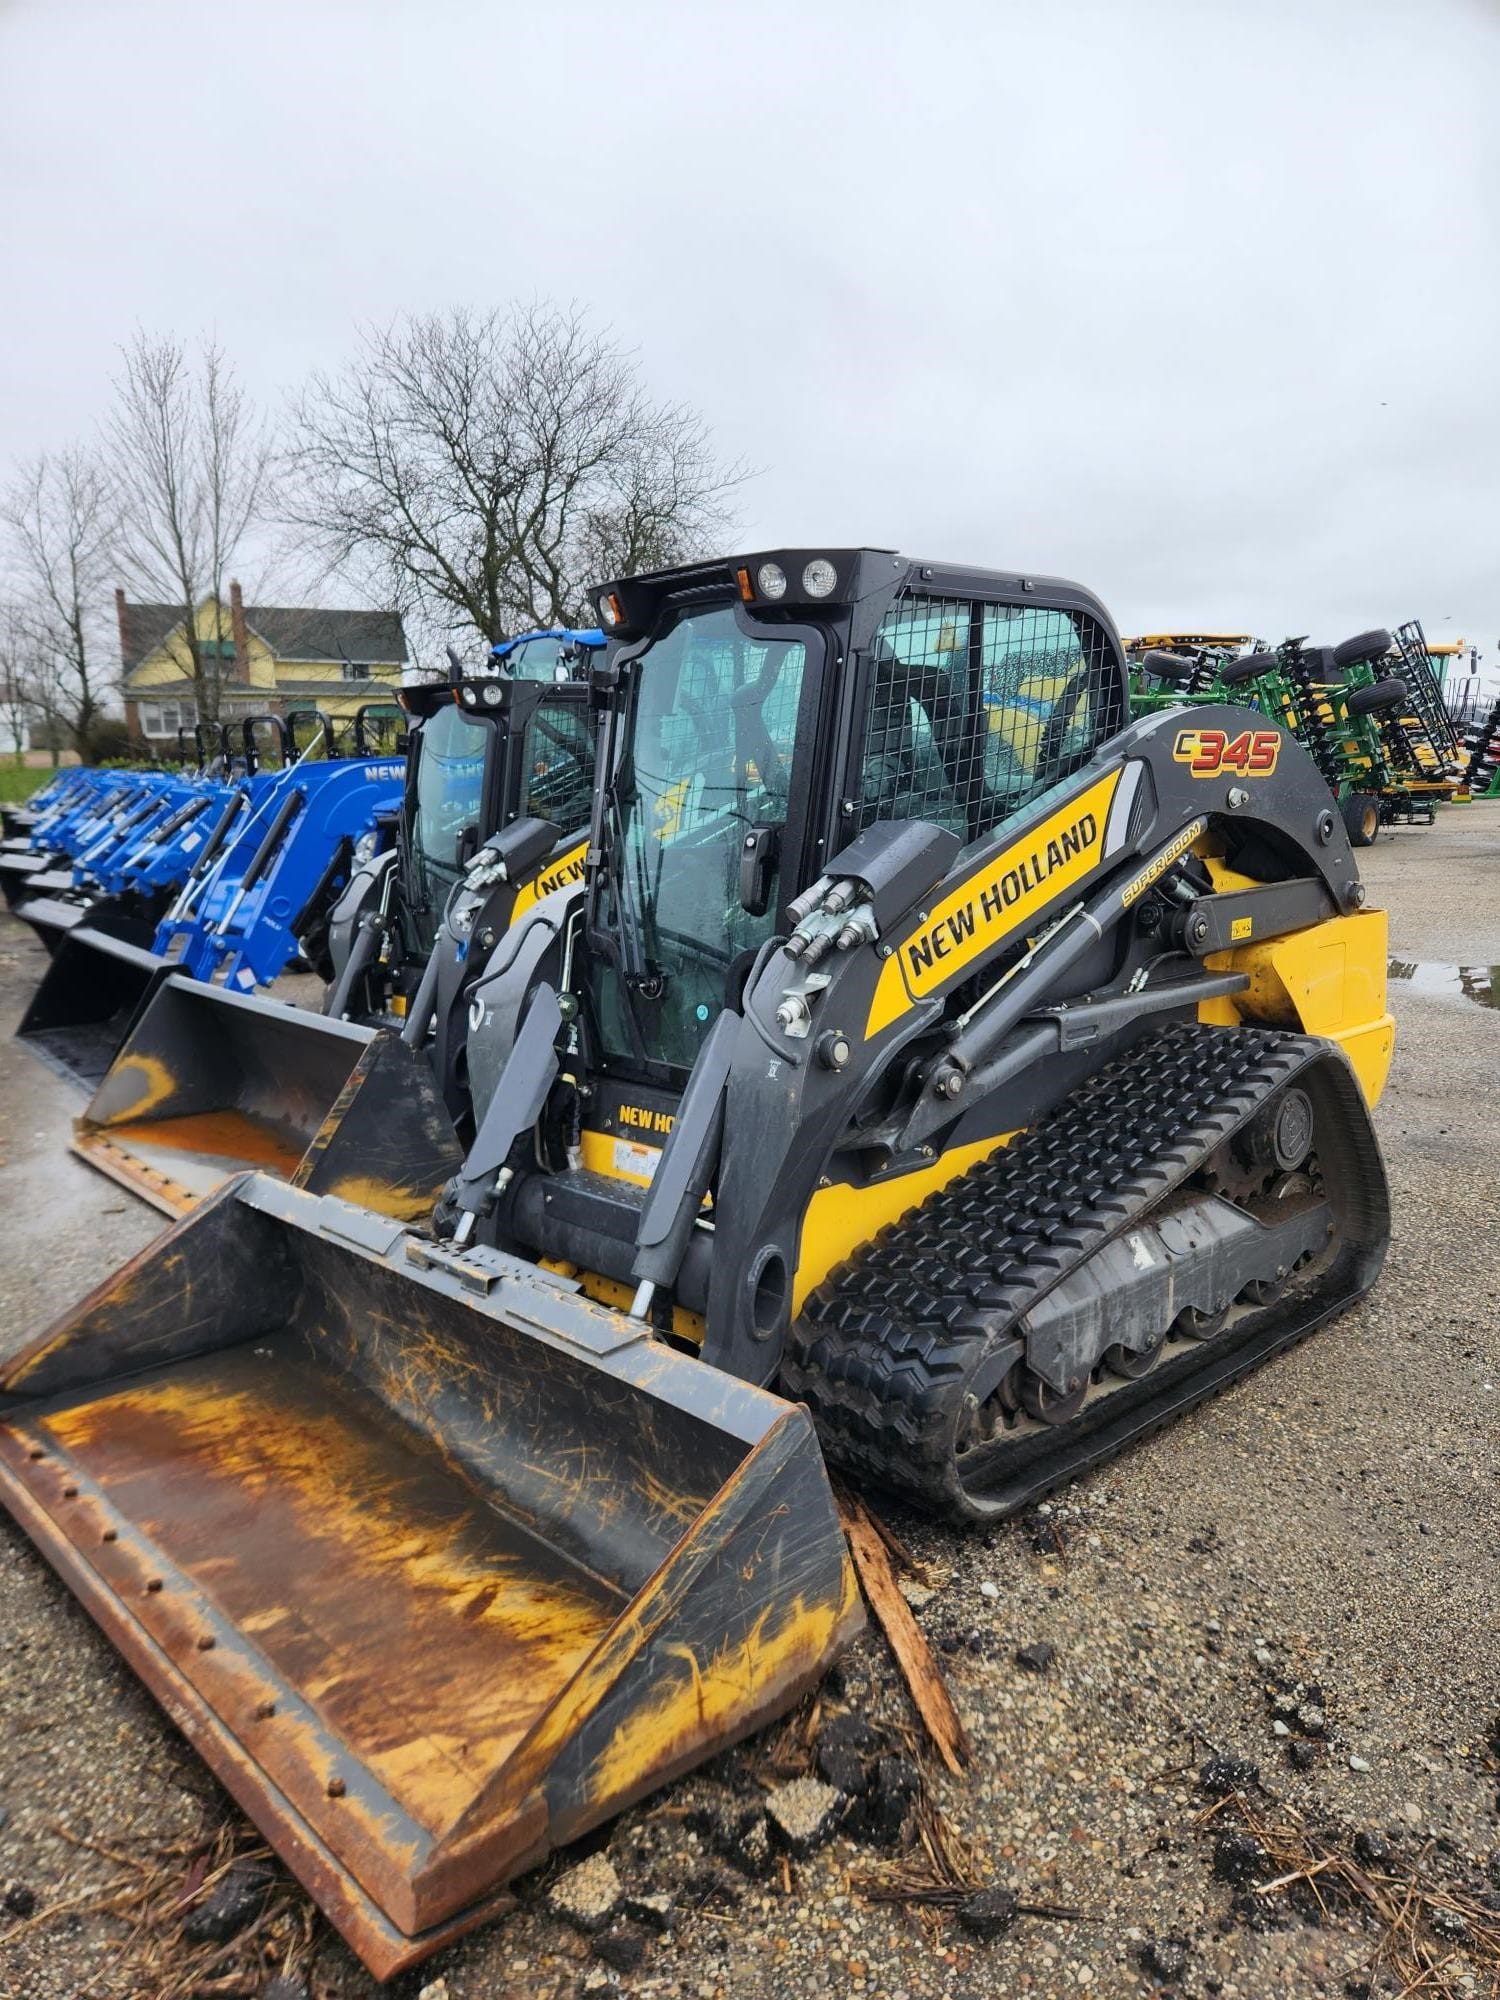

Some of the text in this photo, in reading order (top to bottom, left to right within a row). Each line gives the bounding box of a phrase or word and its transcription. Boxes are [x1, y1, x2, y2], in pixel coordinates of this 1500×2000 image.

[1173, 730, 1282, 778] C345
[364, 766, 406, 781] NEW
[541, 858, 586, 895] NEW
[908, 812, 1097, 976] NEW HOLLAND
[619, 1104, 653, 1130] NEW
